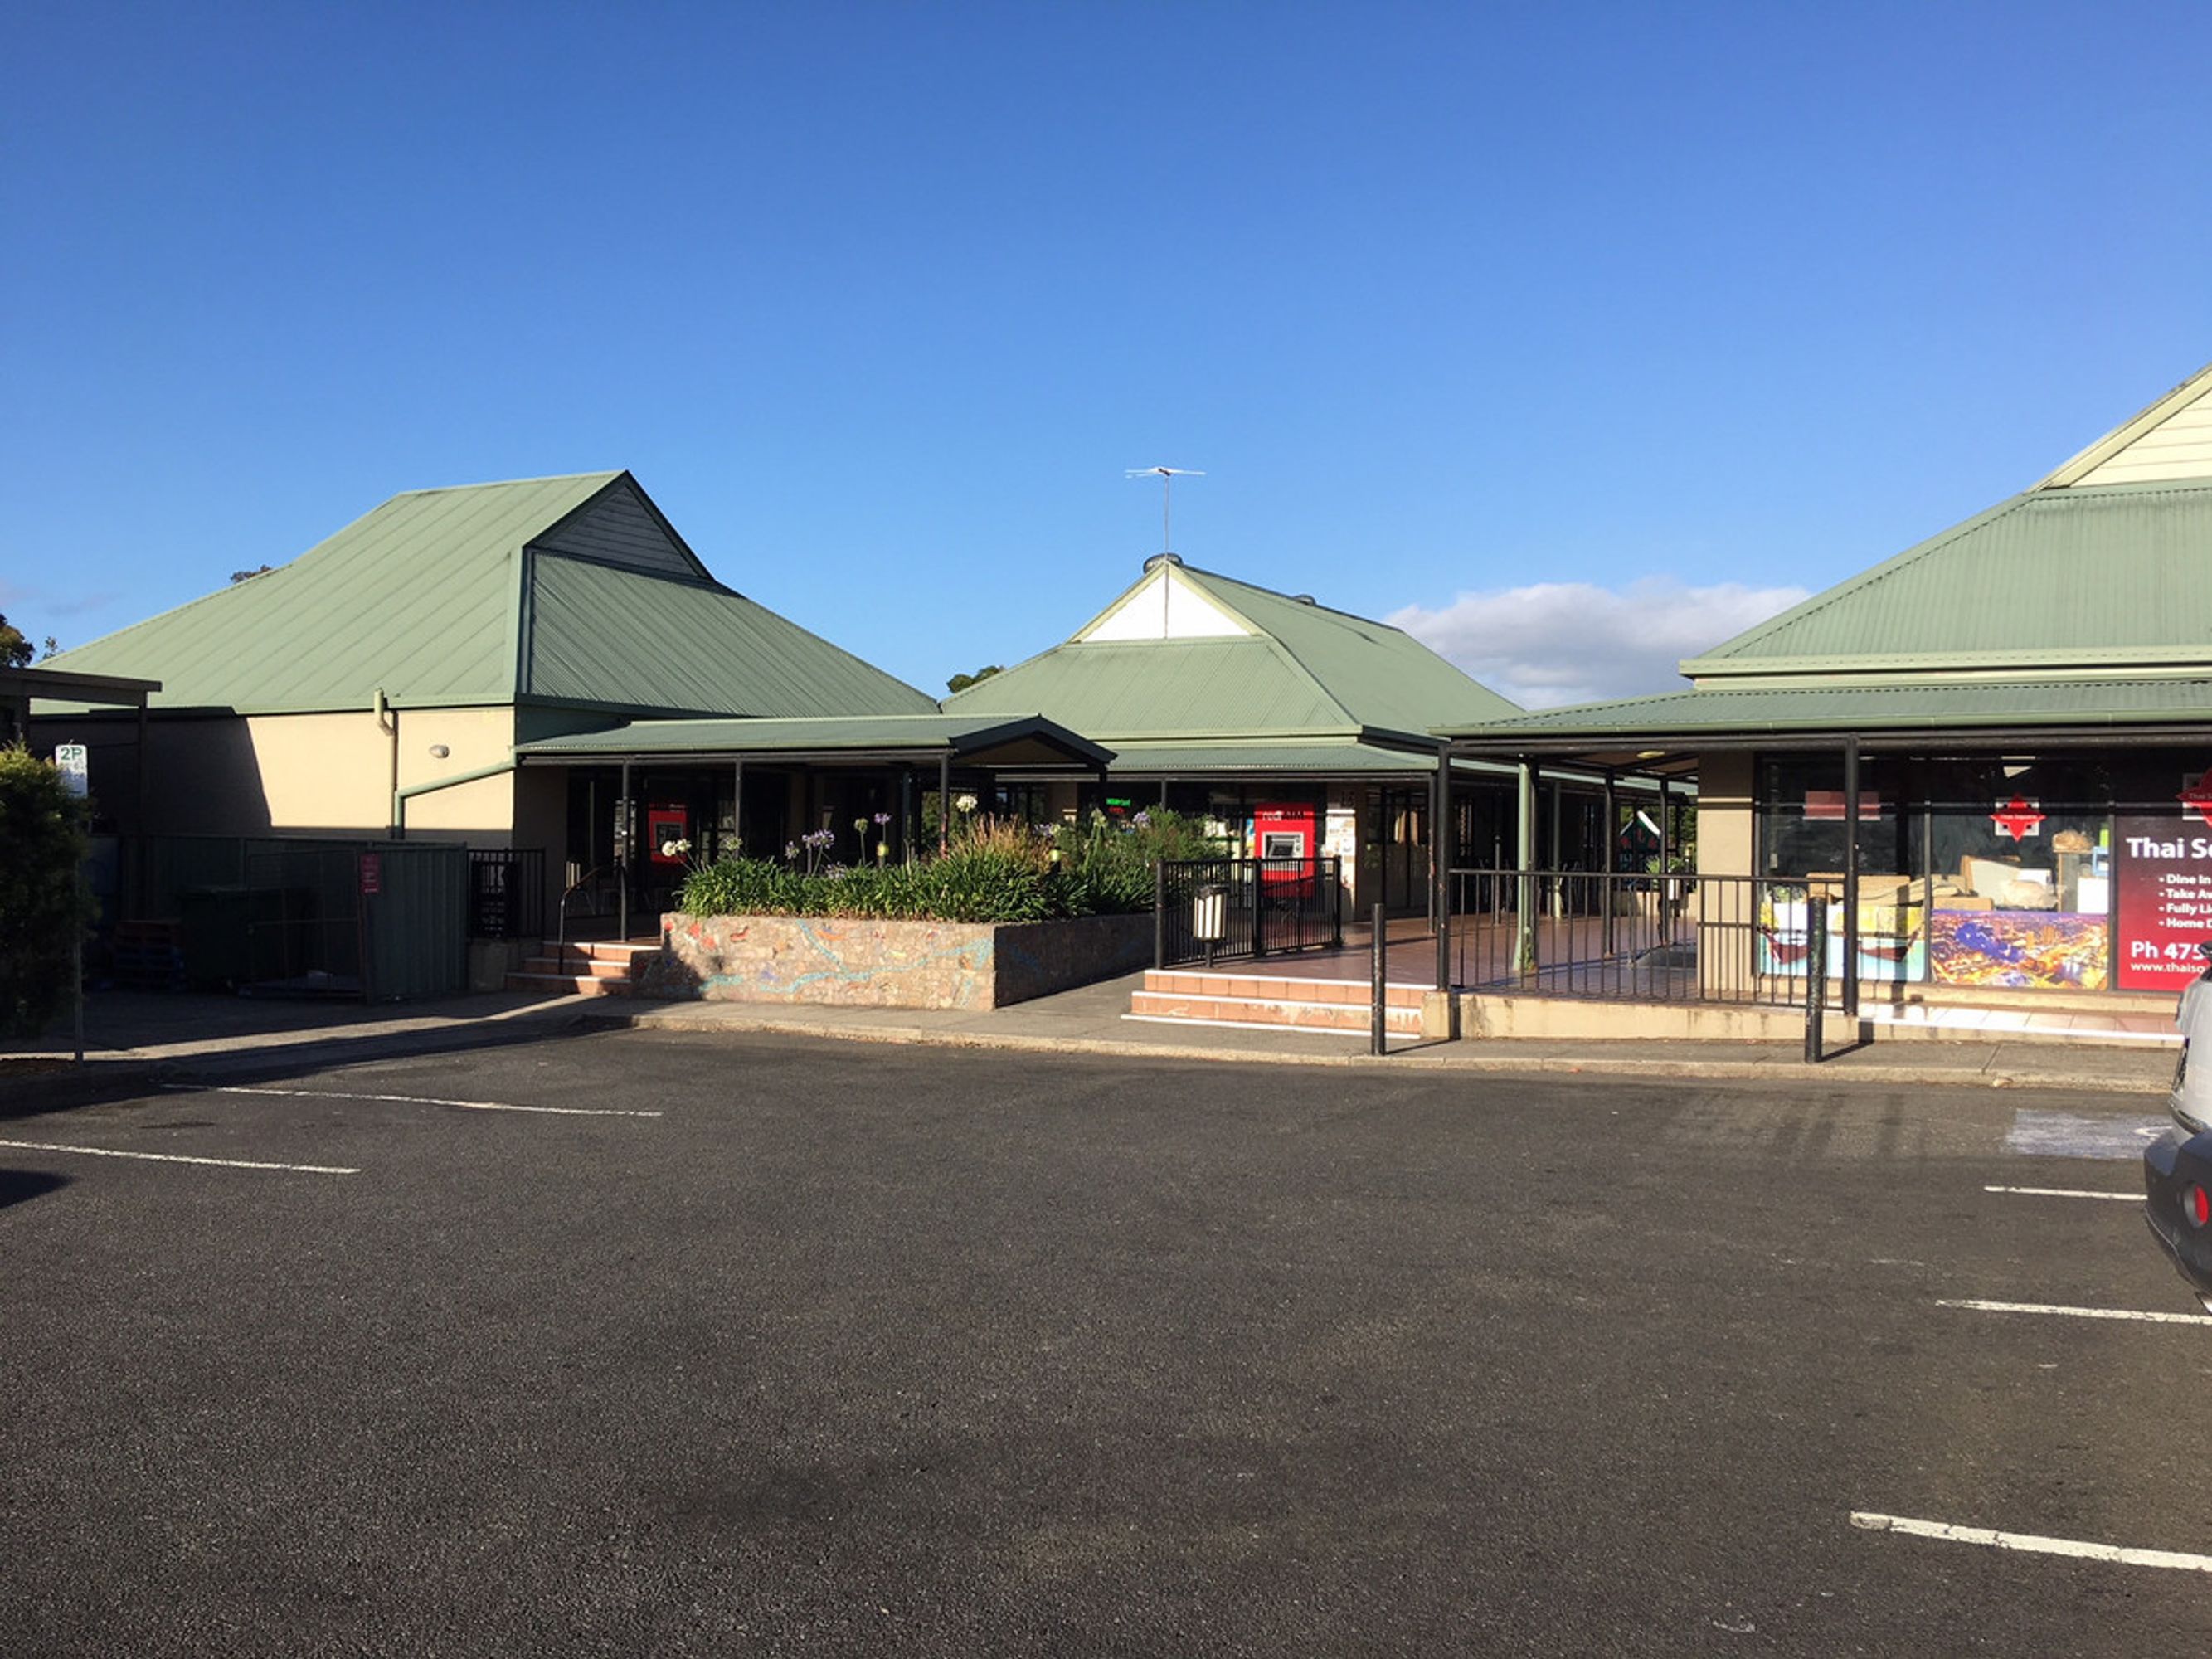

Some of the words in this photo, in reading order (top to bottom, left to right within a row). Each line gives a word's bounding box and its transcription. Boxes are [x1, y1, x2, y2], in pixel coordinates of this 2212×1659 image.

[61, 747, 83, 760] 2P
[2126, 837, 2185, 859] Thai
[2166, 873, 2196, 885] Dine
[2199, 874, 2212, 885] In
[2166, 888, 2195, 899] Take
[2166, 902, 2197, 916] Fully
[2166, 917, 2204, 928] Home
[2132, 941, 2158, 959] Ph
